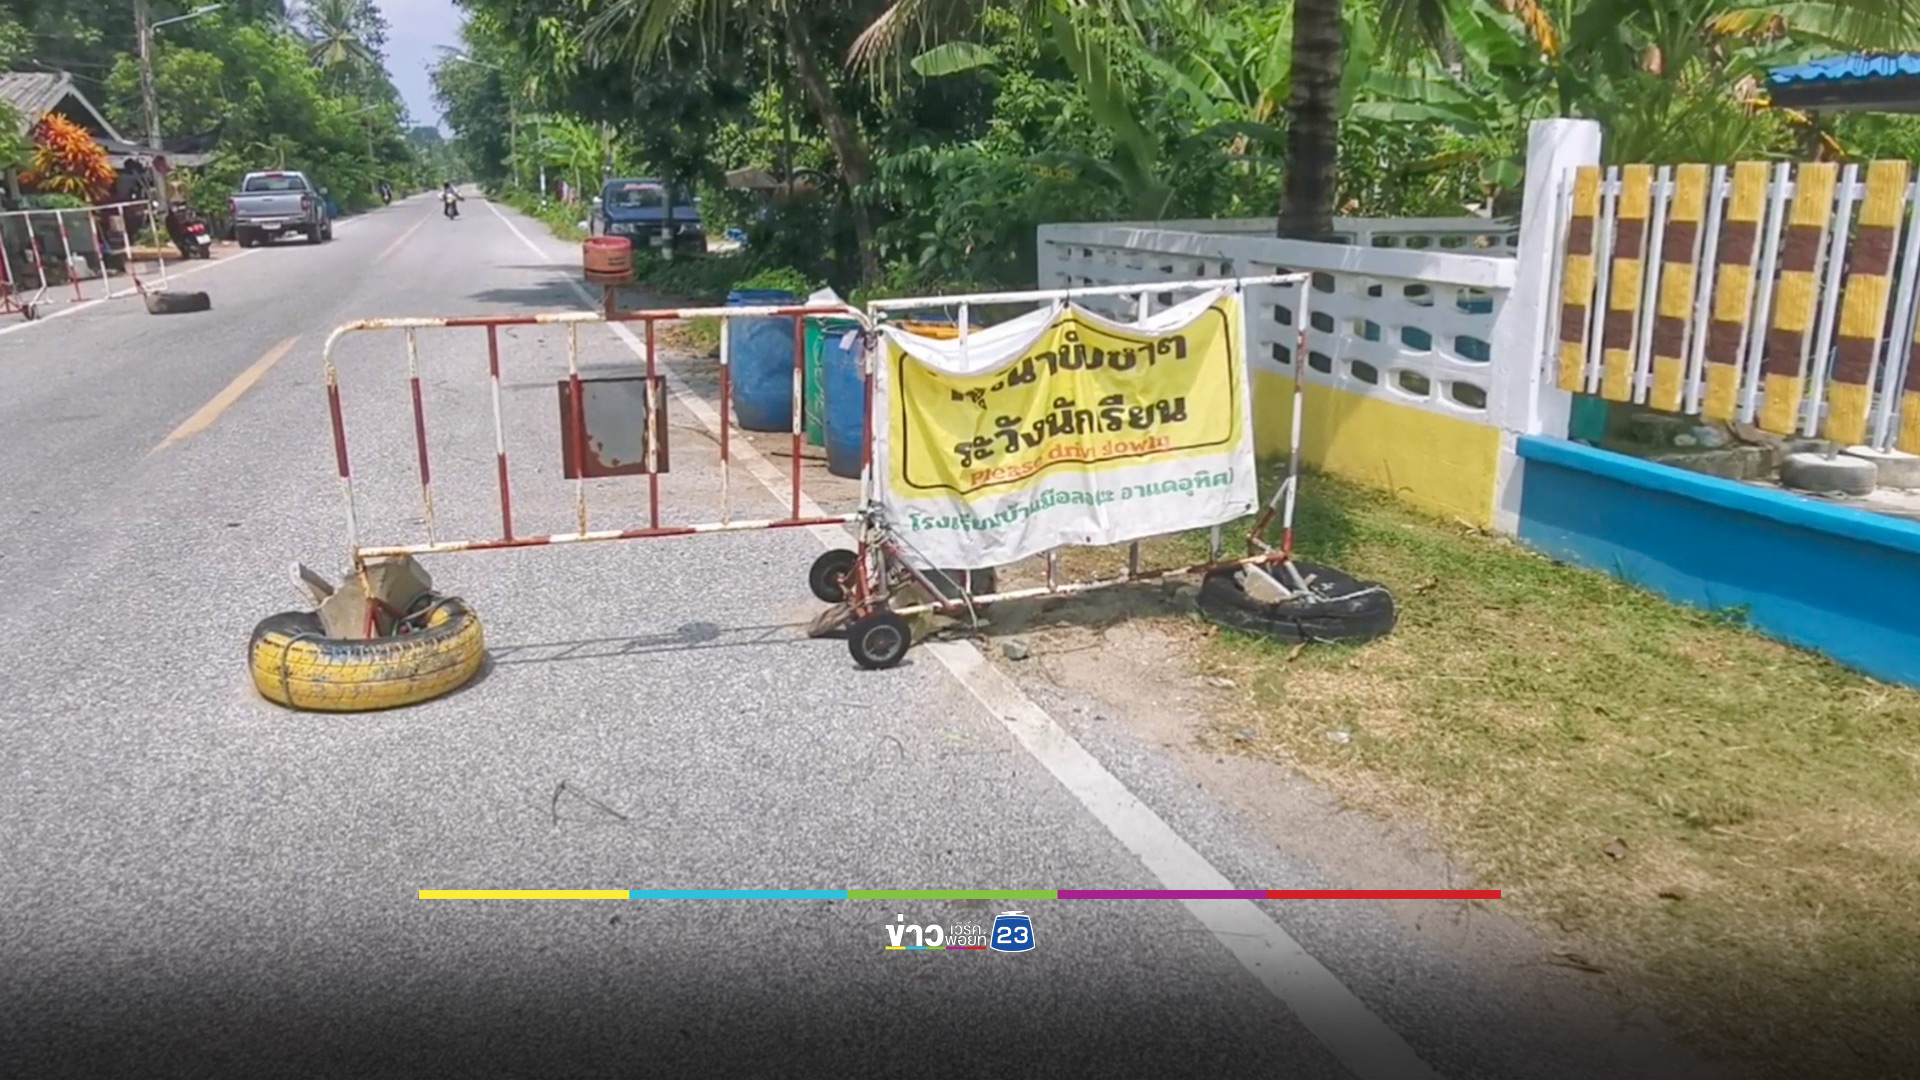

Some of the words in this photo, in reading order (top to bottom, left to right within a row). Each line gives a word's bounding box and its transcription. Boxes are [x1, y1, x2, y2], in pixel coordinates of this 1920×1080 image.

[954, 394, 1188, 468] ระวังนักเรียน
